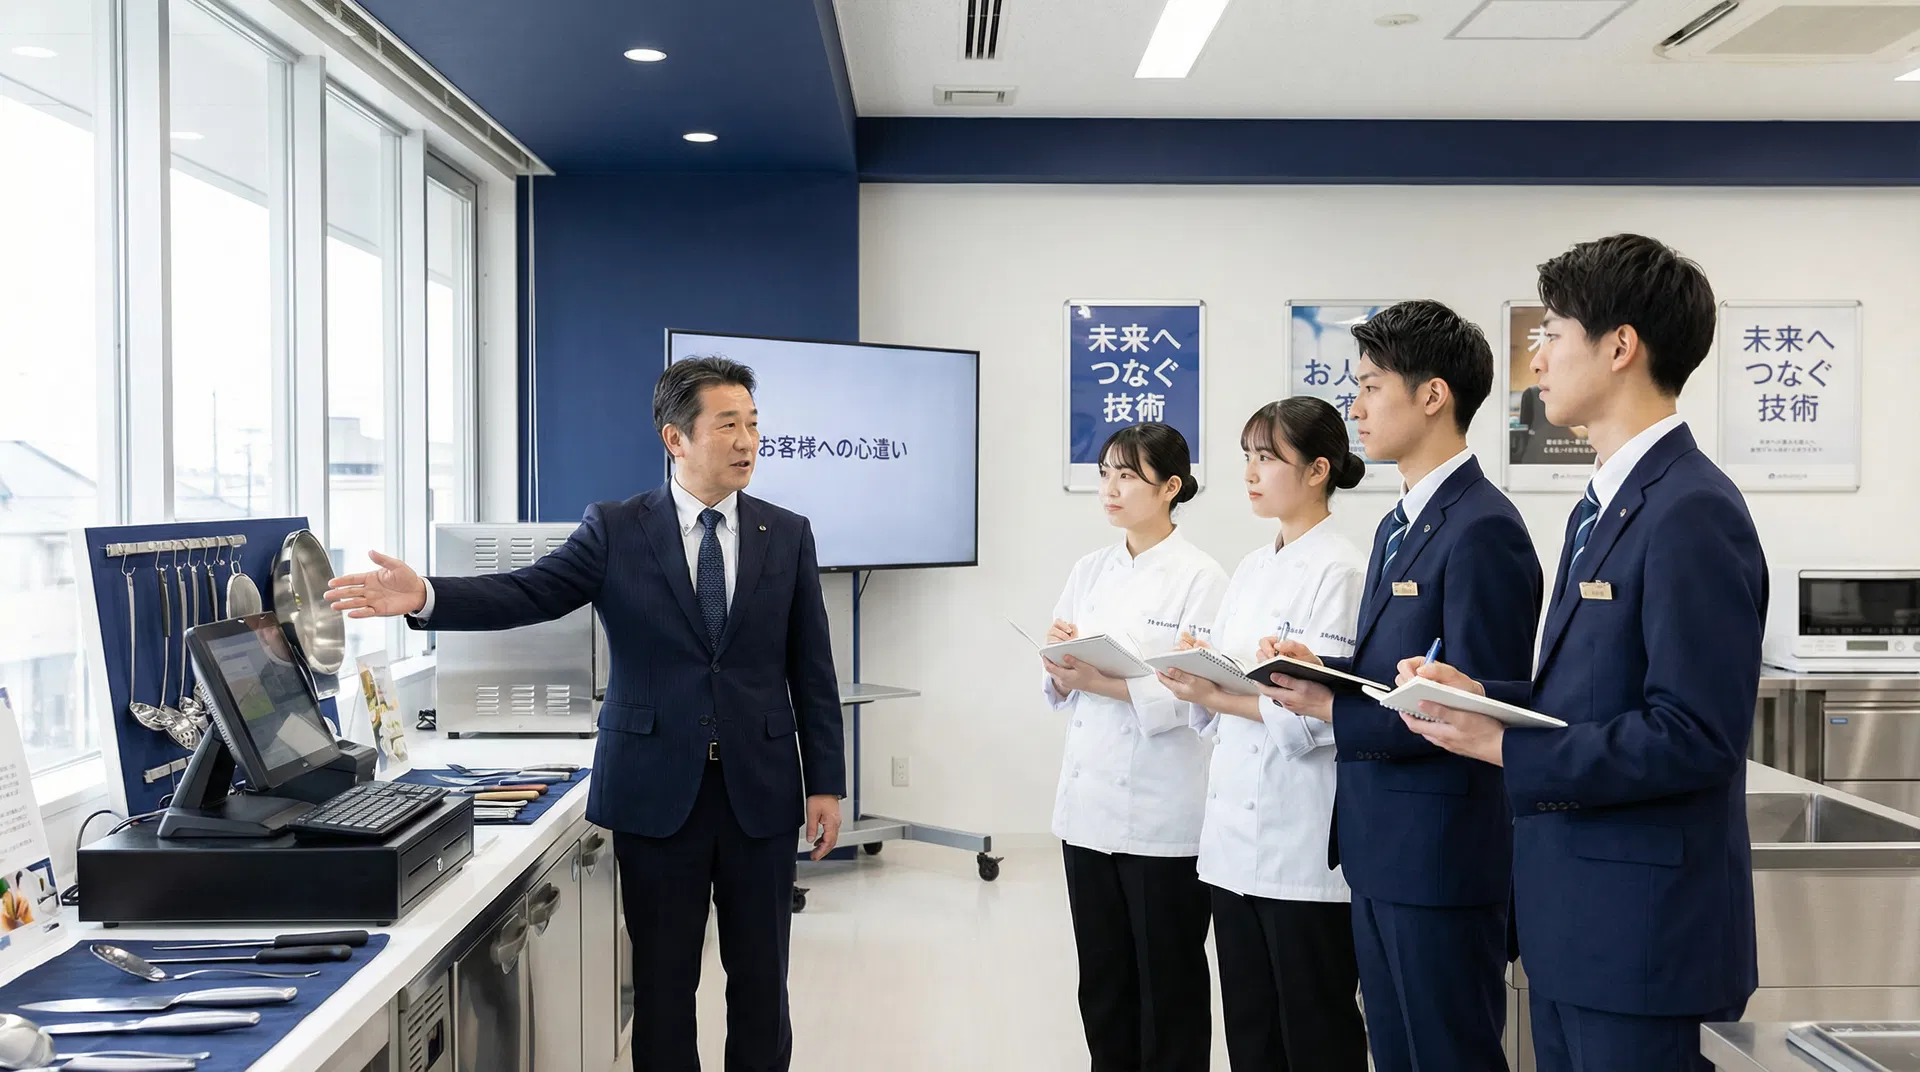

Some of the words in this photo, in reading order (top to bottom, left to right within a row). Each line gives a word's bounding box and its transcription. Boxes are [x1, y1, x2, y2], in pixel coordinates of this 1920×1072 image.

[1088, 324, 1182, 354] 未来へ
[1743, 325, 1835, 353] 未来へ
[1090, 357, 1180, 388] つなぐ
[1745, 359, 1833, 388] つなぐ
[1103, 393, 1165, 423] 技術
[1758, 393, 1820, 423] 技術
[758, 435, 908, 460] お客様への心遣い
